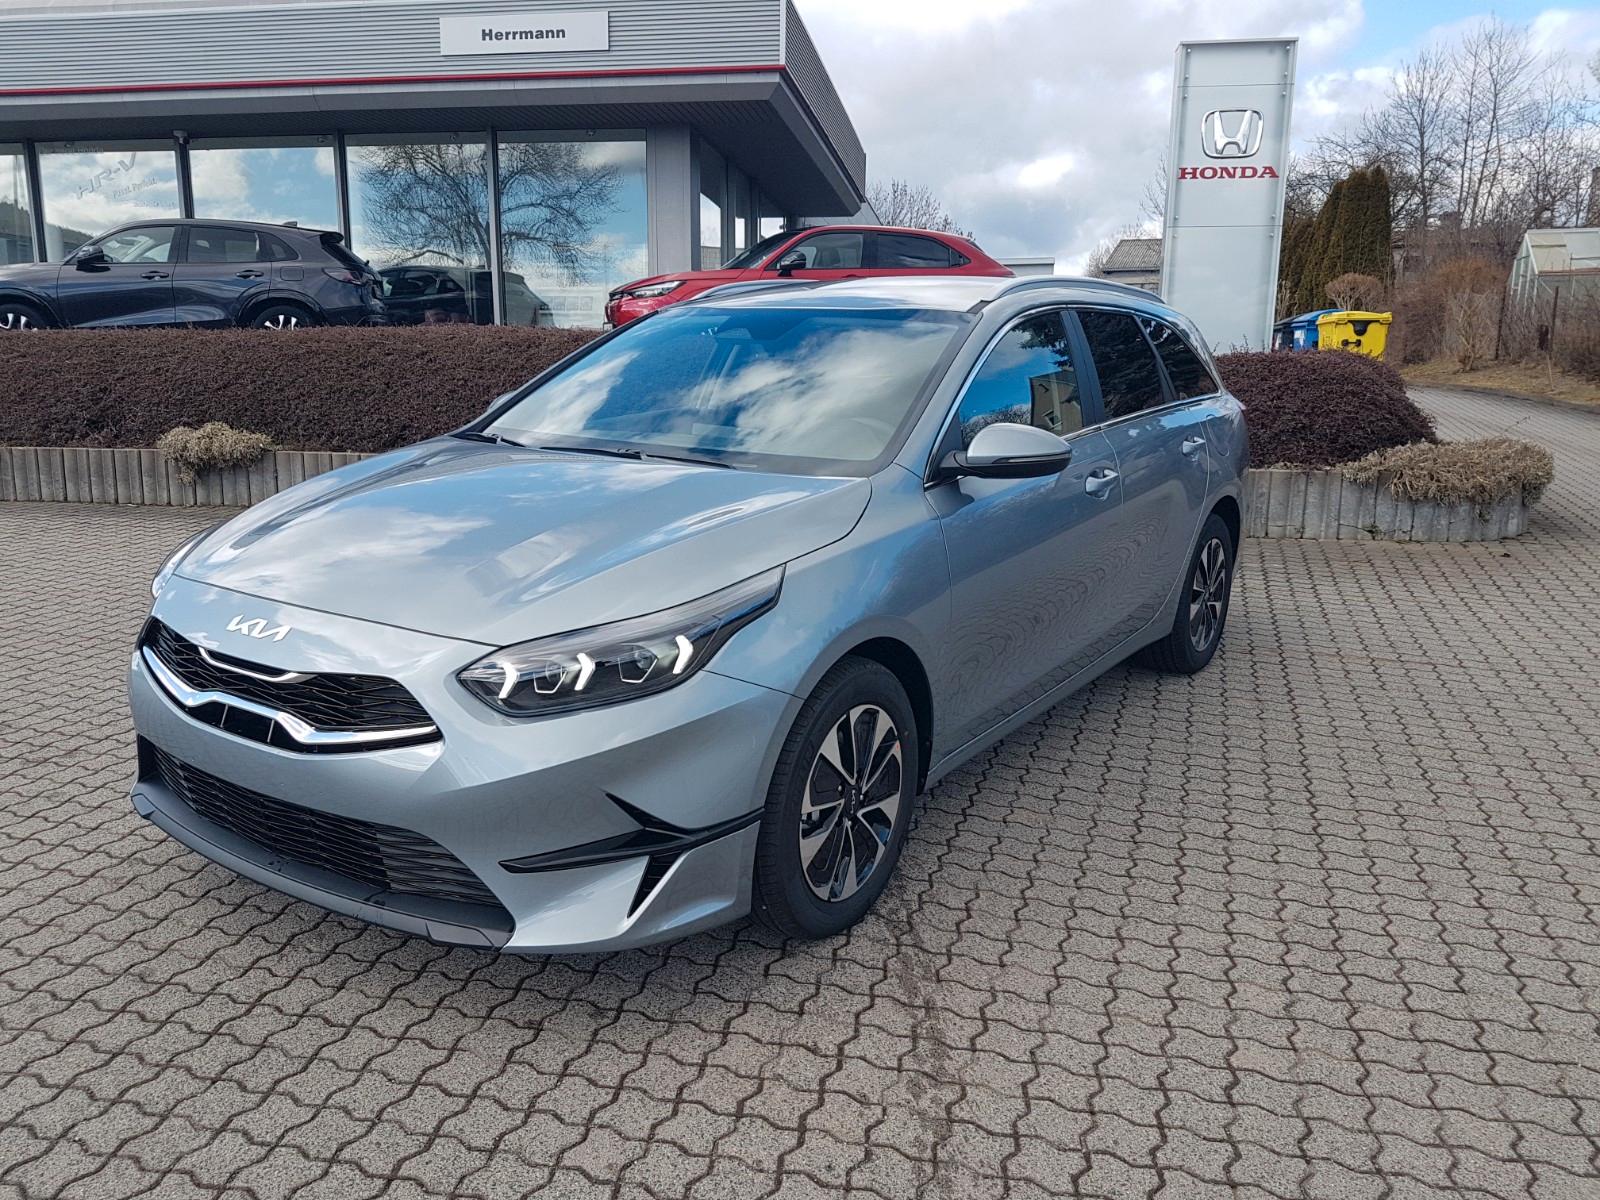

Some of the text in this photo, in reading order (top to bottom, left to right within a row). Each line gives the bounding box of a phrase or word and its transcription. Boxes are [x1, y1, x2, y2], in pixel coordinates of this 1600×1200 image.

[481, 28, 566, 41] Herrmann
[1178, 166, 1280, 180] HONDA
[225, 614, 292, 643] KIA
